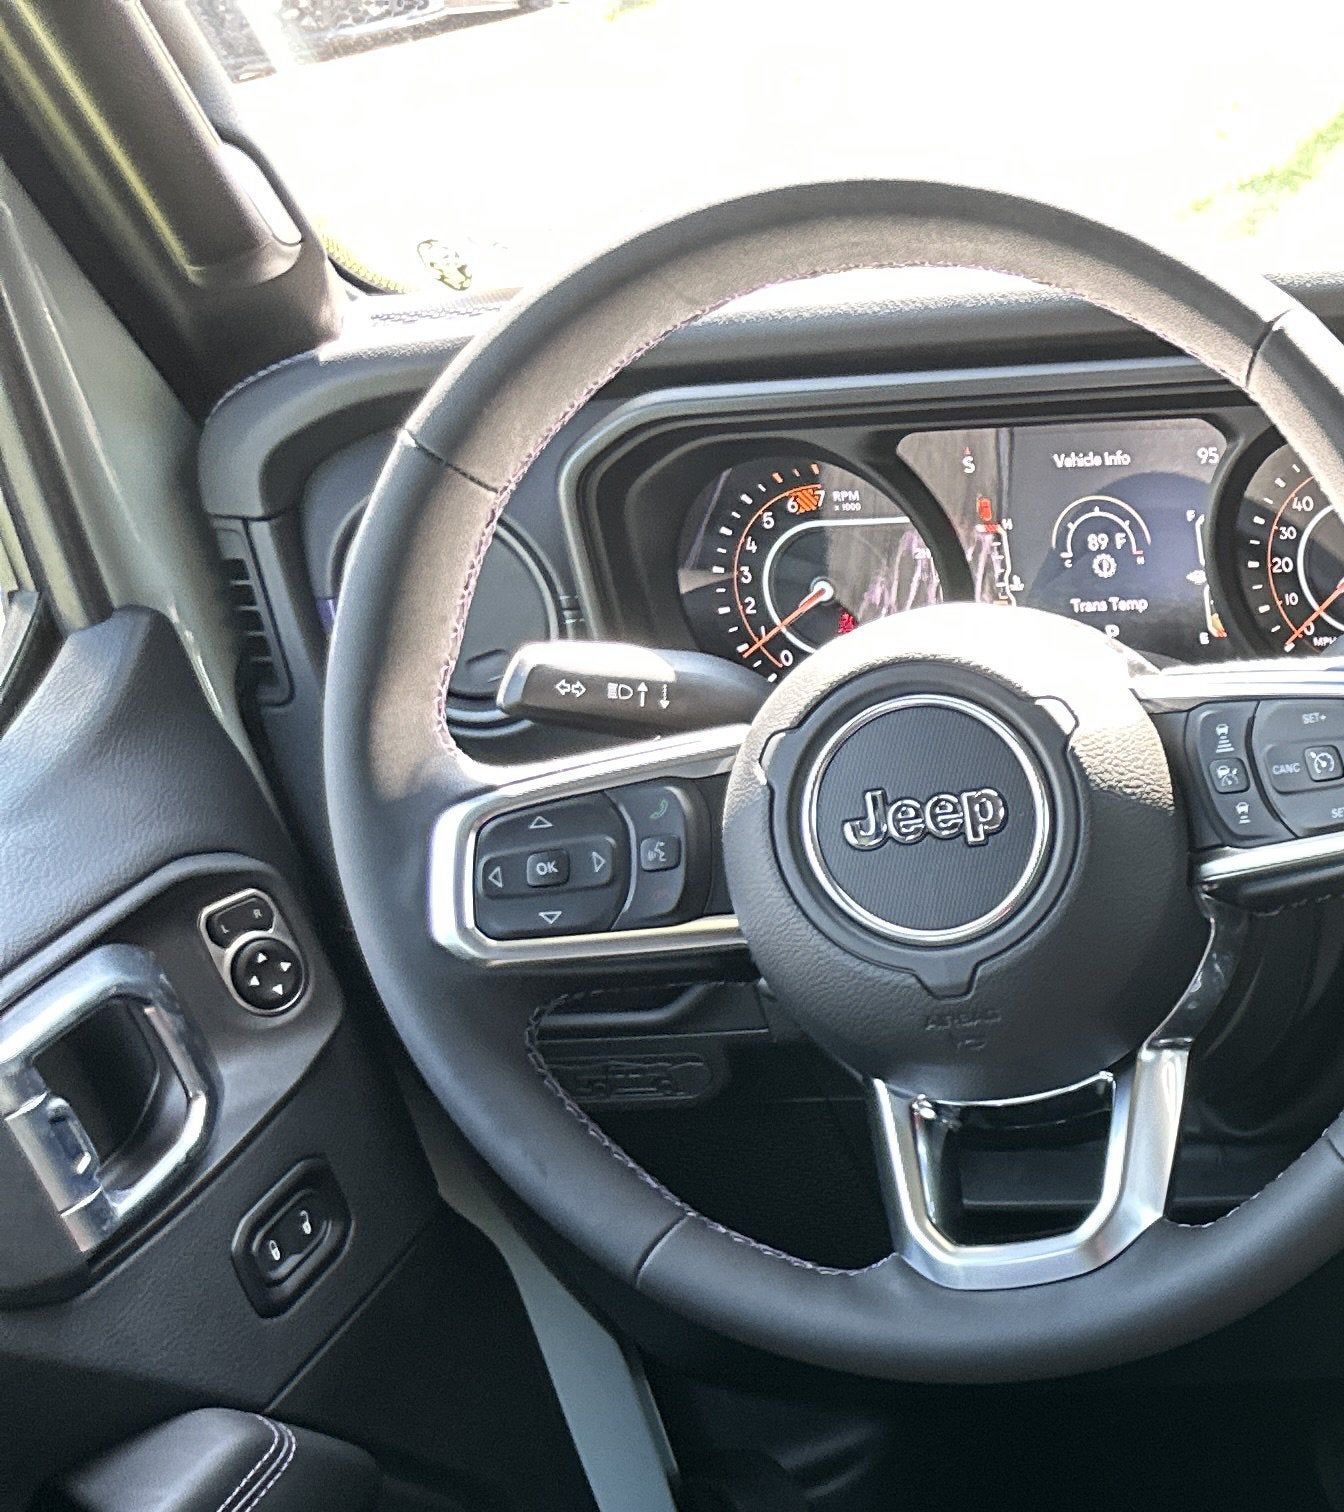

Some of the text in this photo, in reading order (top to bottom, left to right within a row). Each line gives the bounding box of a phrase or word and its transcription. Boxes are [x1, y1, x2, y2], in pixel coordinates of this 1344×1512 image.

[1052, 450, 1131, 469] Vehicle Info
[1197, 447, 1219, 465] 95
[962, 456, 976, 474] S
[815, 490, 826, 508] 7
[832, 490, 860, 501] RPM
[1292, 495, 1314, 512] 40
[786, 499, 800, 514] 6
[841, 502, 861, 512] 1000
[762, 511, 775, 529] 5
[1279, 526, 1297, 540] 30
[746, 536, 757, 553] 4
[1087, 533, 1109, 551] 89
[1271, 556, 1293, 573] 20
[740, 566, 752, 584] 3
[744, 597, 757, 614] 2
[1069, 596, 1149, 613] Trans Temp
[1285, 592, 1299, 606] 10
[780, 650, 794, 666] 0
[1302, 713, 1327, 724] SET+
[1272, 762, 1300, 775] CANC
[843, 788, 1005, 850] Jeep
[536, 861, 558, 875] OK
